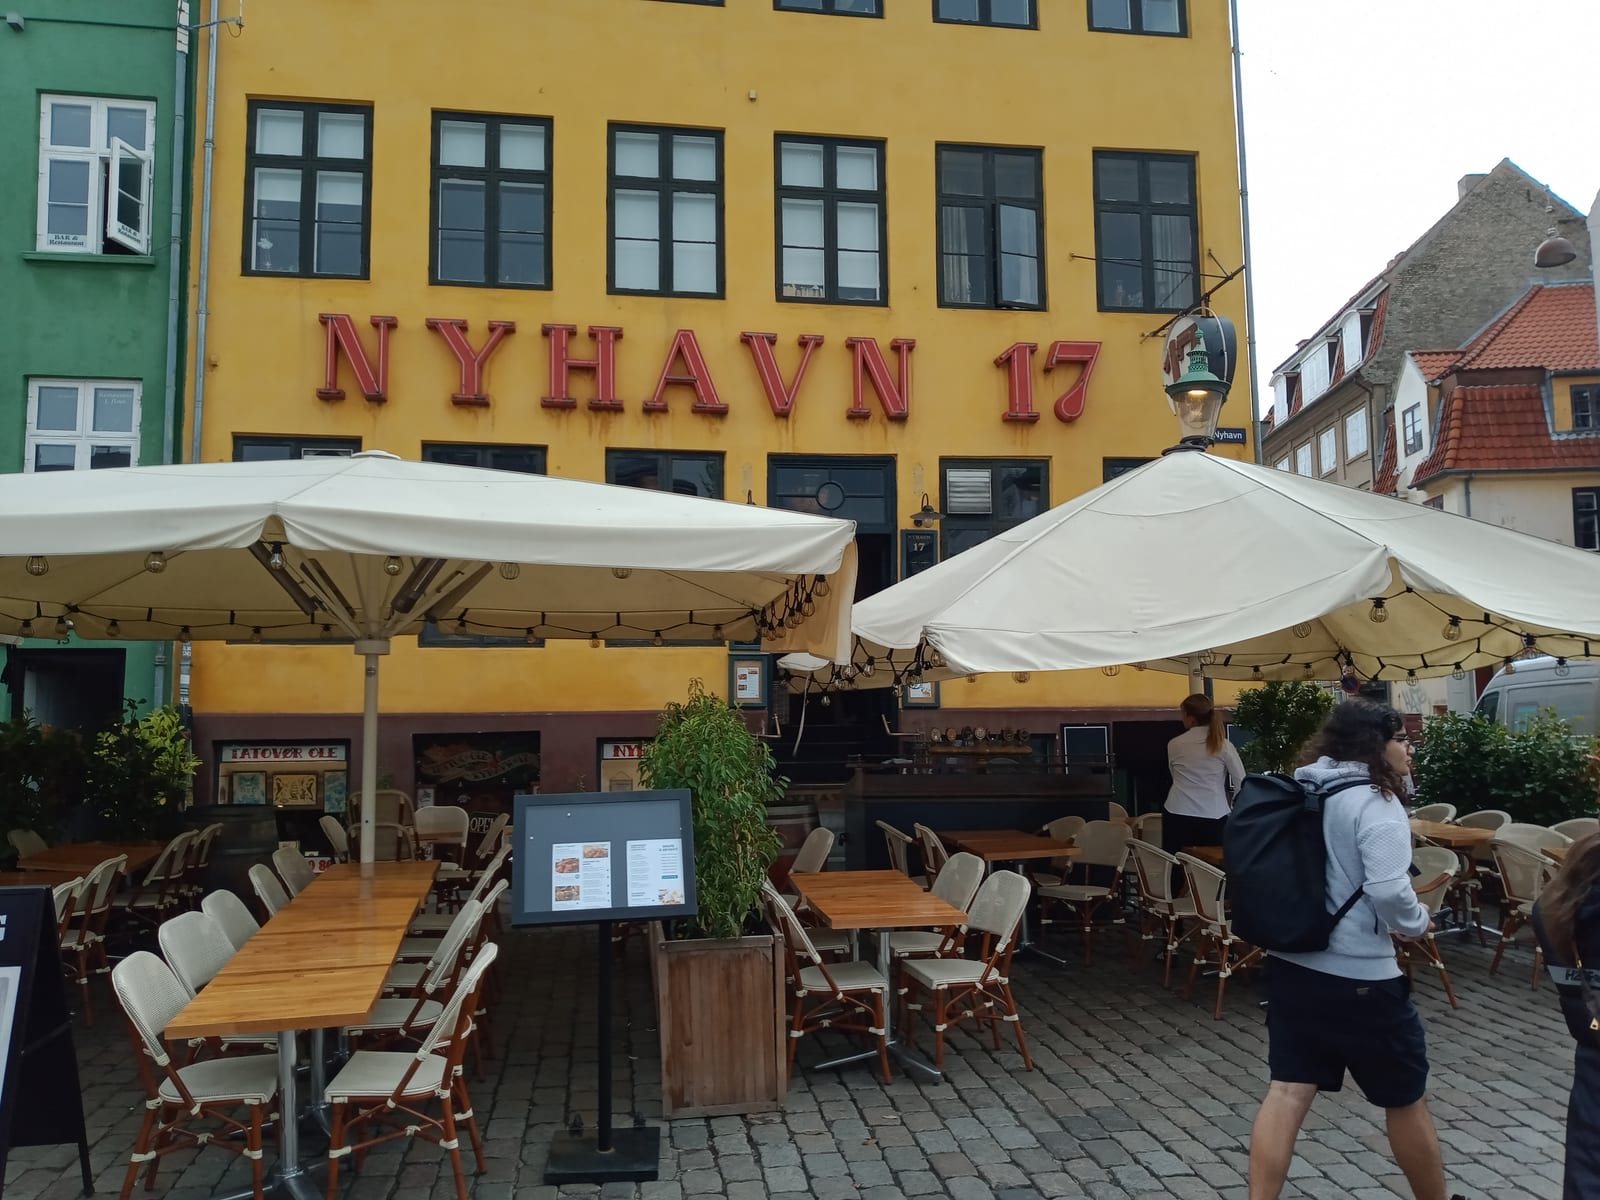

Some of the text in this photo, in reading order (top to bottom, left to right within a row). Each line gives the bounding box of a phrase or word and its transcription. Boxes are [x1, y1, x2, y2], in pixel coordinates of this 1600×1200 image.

[316, 312, 1103, 424] NYHAVN 17
[1214, 430, 1243, 441] Nyhavn
[913, 542, 926, 552] 17
[307, 746, 339, 759] OLE
